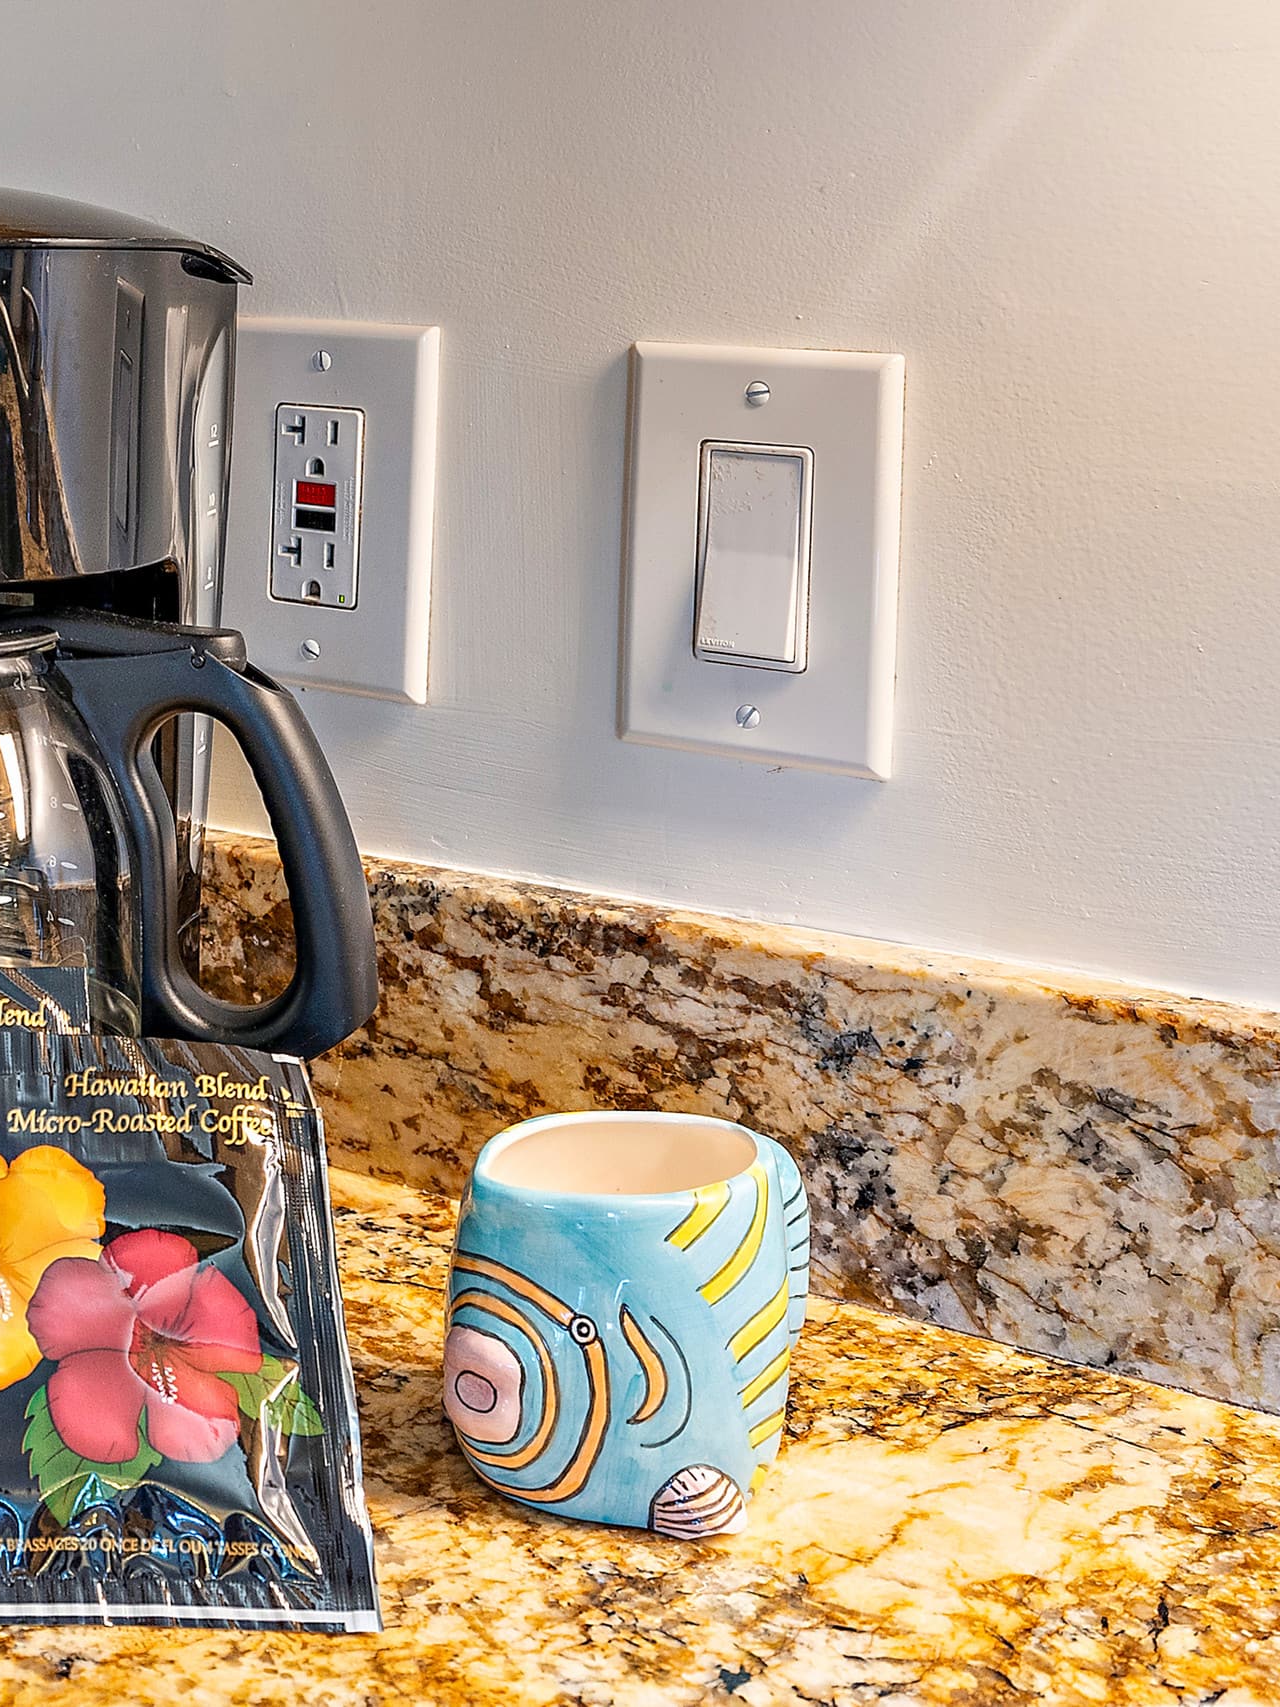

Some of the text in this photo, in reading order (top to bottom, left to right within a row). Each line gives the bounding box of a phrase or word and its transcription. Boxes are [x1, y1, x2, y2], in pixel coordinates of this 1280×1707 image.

[65, 1067, 270, 1100] Hawaiian Blend
[7, 1103, 198, 1134] Micro-Roasted
[200, 1105, 273, 1145] Coffee
